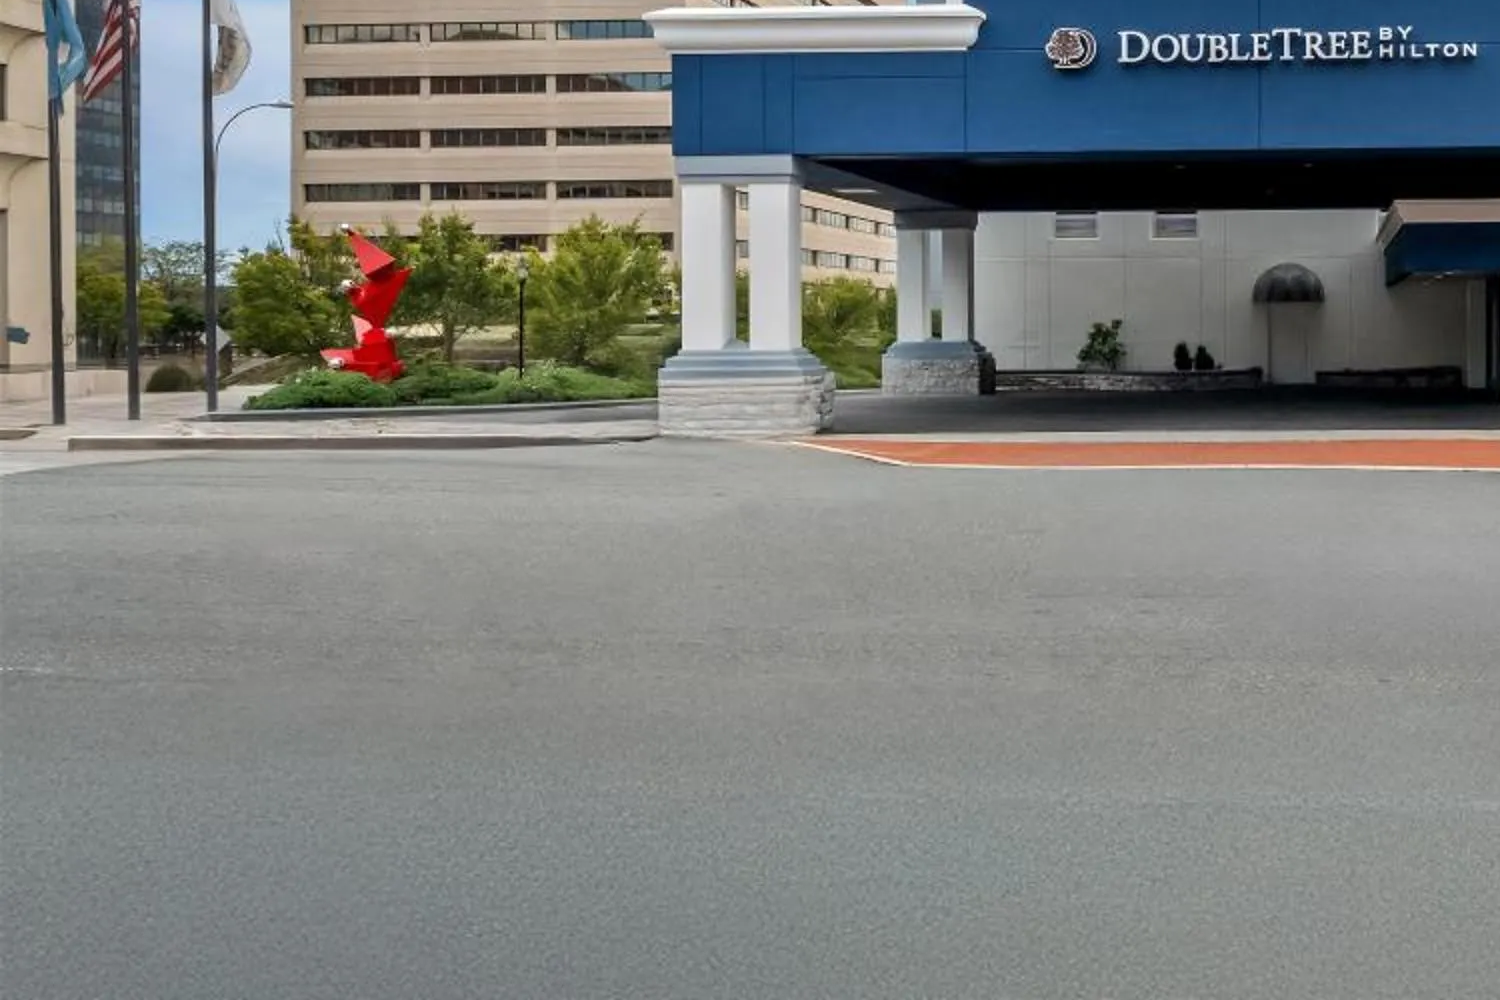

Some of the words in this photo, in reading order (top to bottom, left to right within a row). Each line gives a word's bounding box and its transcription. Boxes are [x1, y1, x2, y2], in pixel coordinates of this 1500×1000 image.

[1379, 26, 1413, 42] BY
[1117, 28, 1374, 64] DOUBLETREE
[1379, 43, 1478, 59] HILTON
